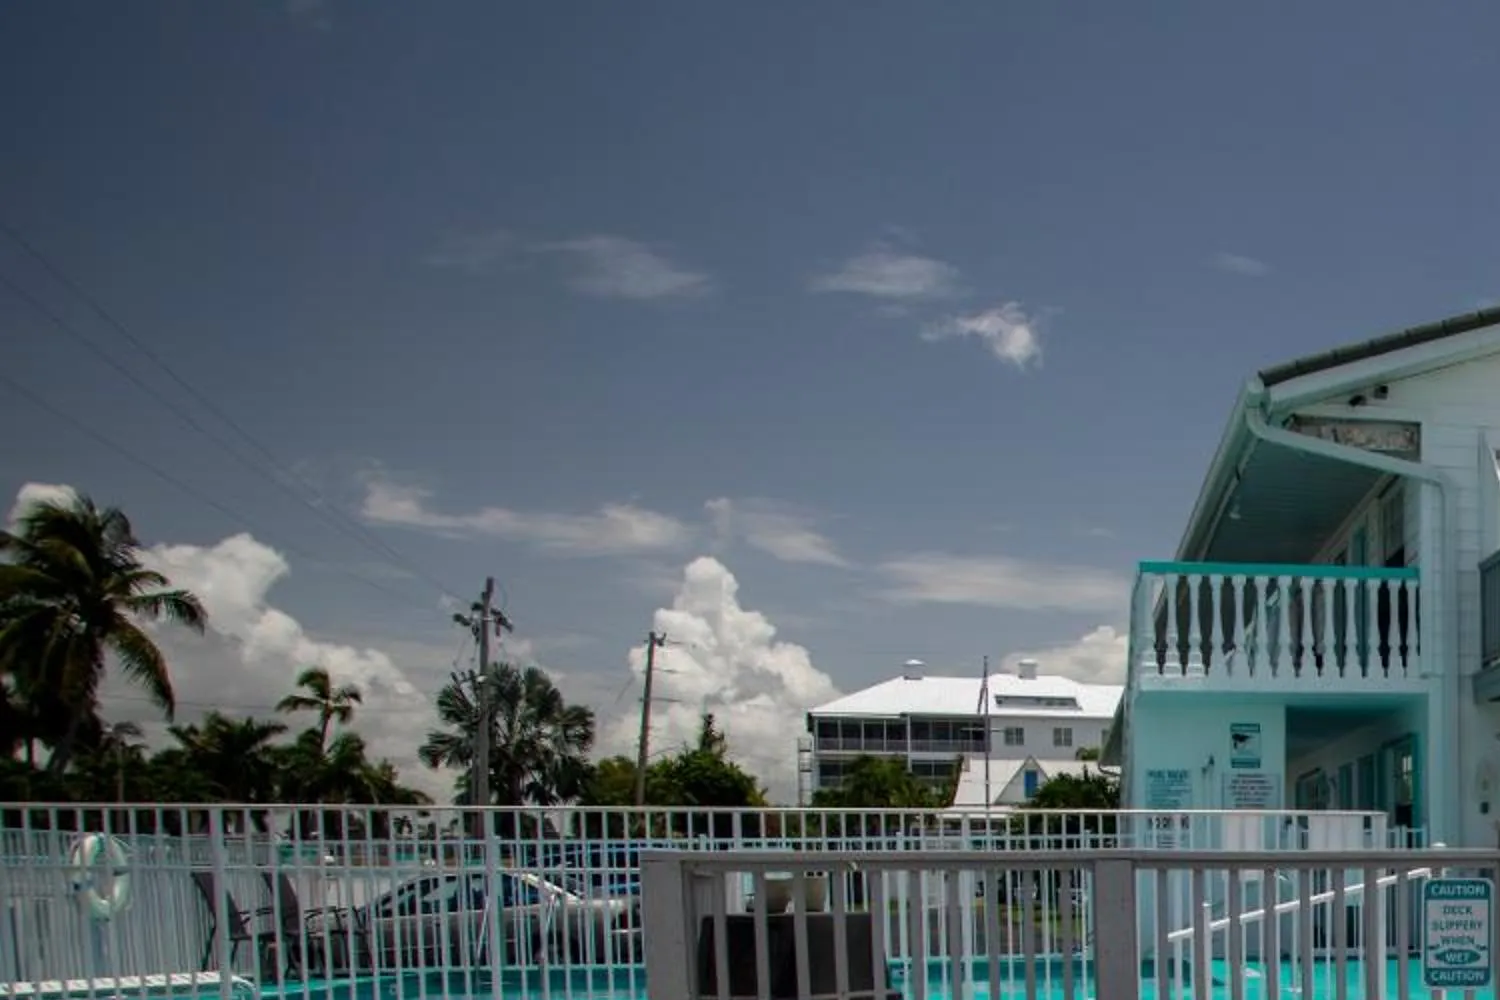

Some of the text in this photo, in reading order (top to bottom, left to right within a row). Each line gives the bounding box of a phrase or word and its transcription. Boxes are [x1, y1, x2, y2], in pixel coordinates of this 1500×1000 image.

[1431, 884, 1485, 896] CAUTION
[1443, 905, 1472, 915] DECK
[1431, 920, 1482, 931] SLIPPERY
[1440, 936, 1475, 945] WHEN
[1445, 952, 1470, 962] WET
[1431, 971, 1485, 981] CAUTION
